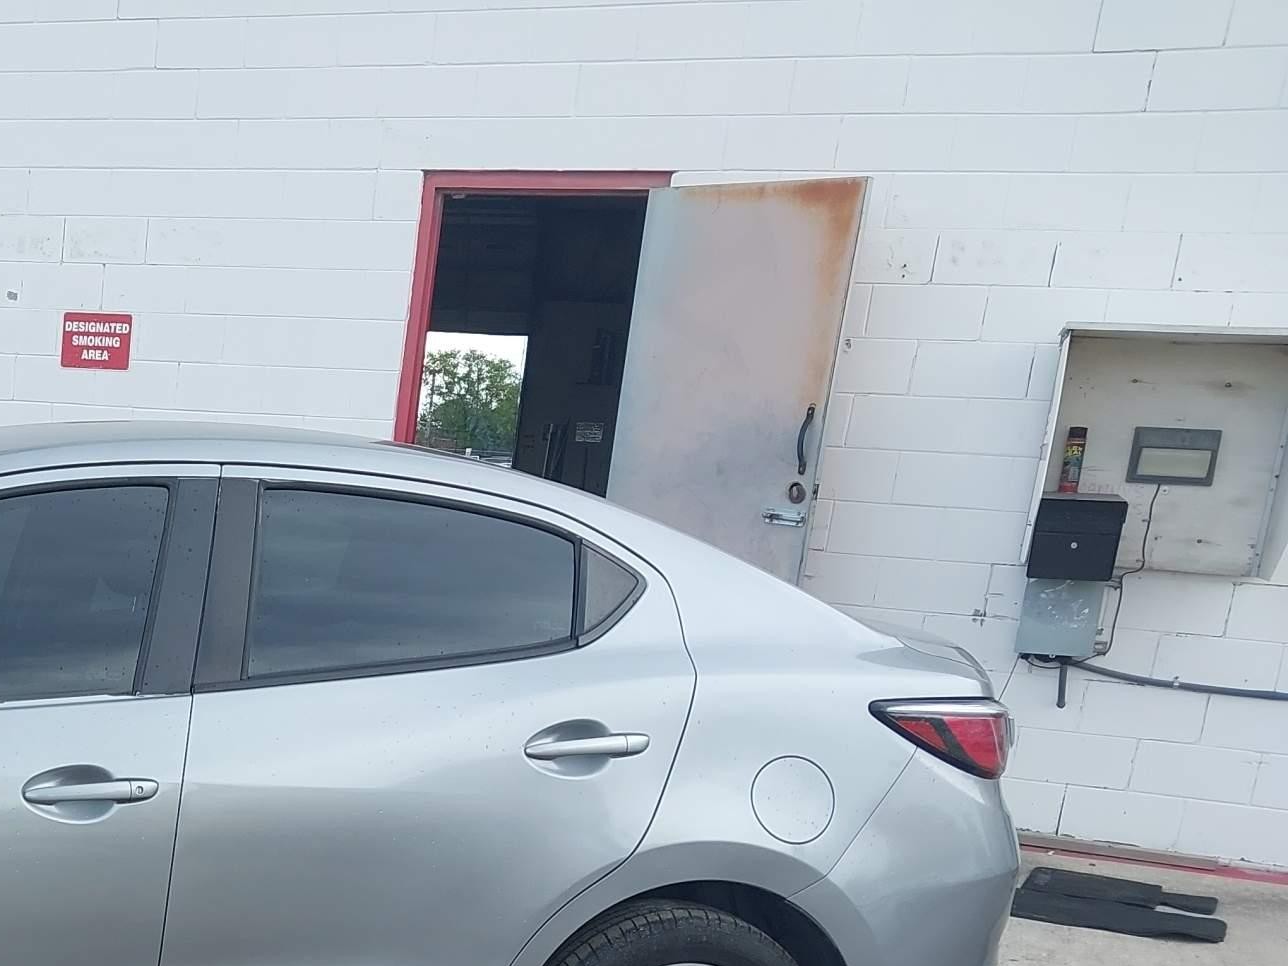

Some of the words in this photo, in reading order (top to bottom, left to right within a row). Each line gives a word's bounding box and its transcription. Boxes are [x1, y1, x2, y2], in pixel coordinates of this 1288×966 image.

[65, 321, 130, 334] DESIGNATED
[72, 334, 121, 348] SMOKING
[81, 349, 109, 361] AREA
